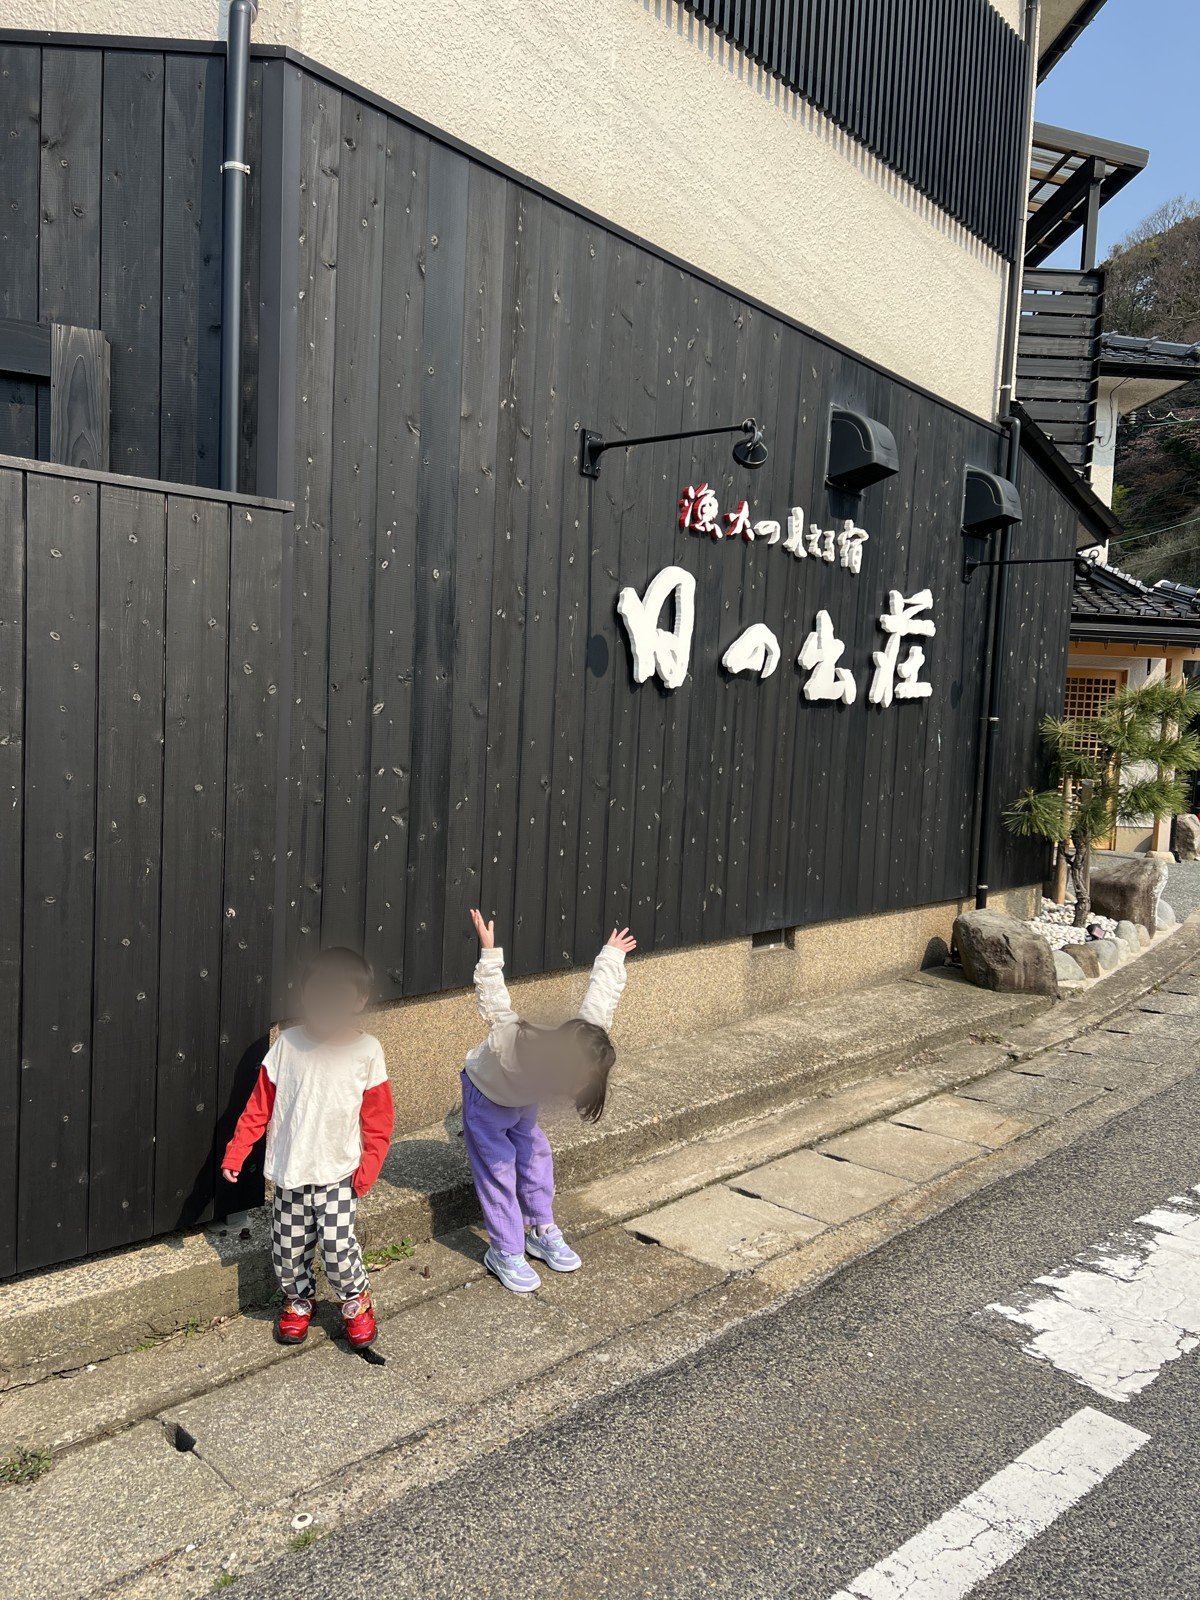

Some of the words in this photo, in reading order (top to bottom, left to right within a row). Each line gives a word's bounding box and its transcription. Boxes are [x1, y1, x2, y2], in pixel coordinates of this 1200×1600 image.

[679, 482, 870, 574] 漁火の見える宿
[617, 565, 937, 708] 日の出荘
